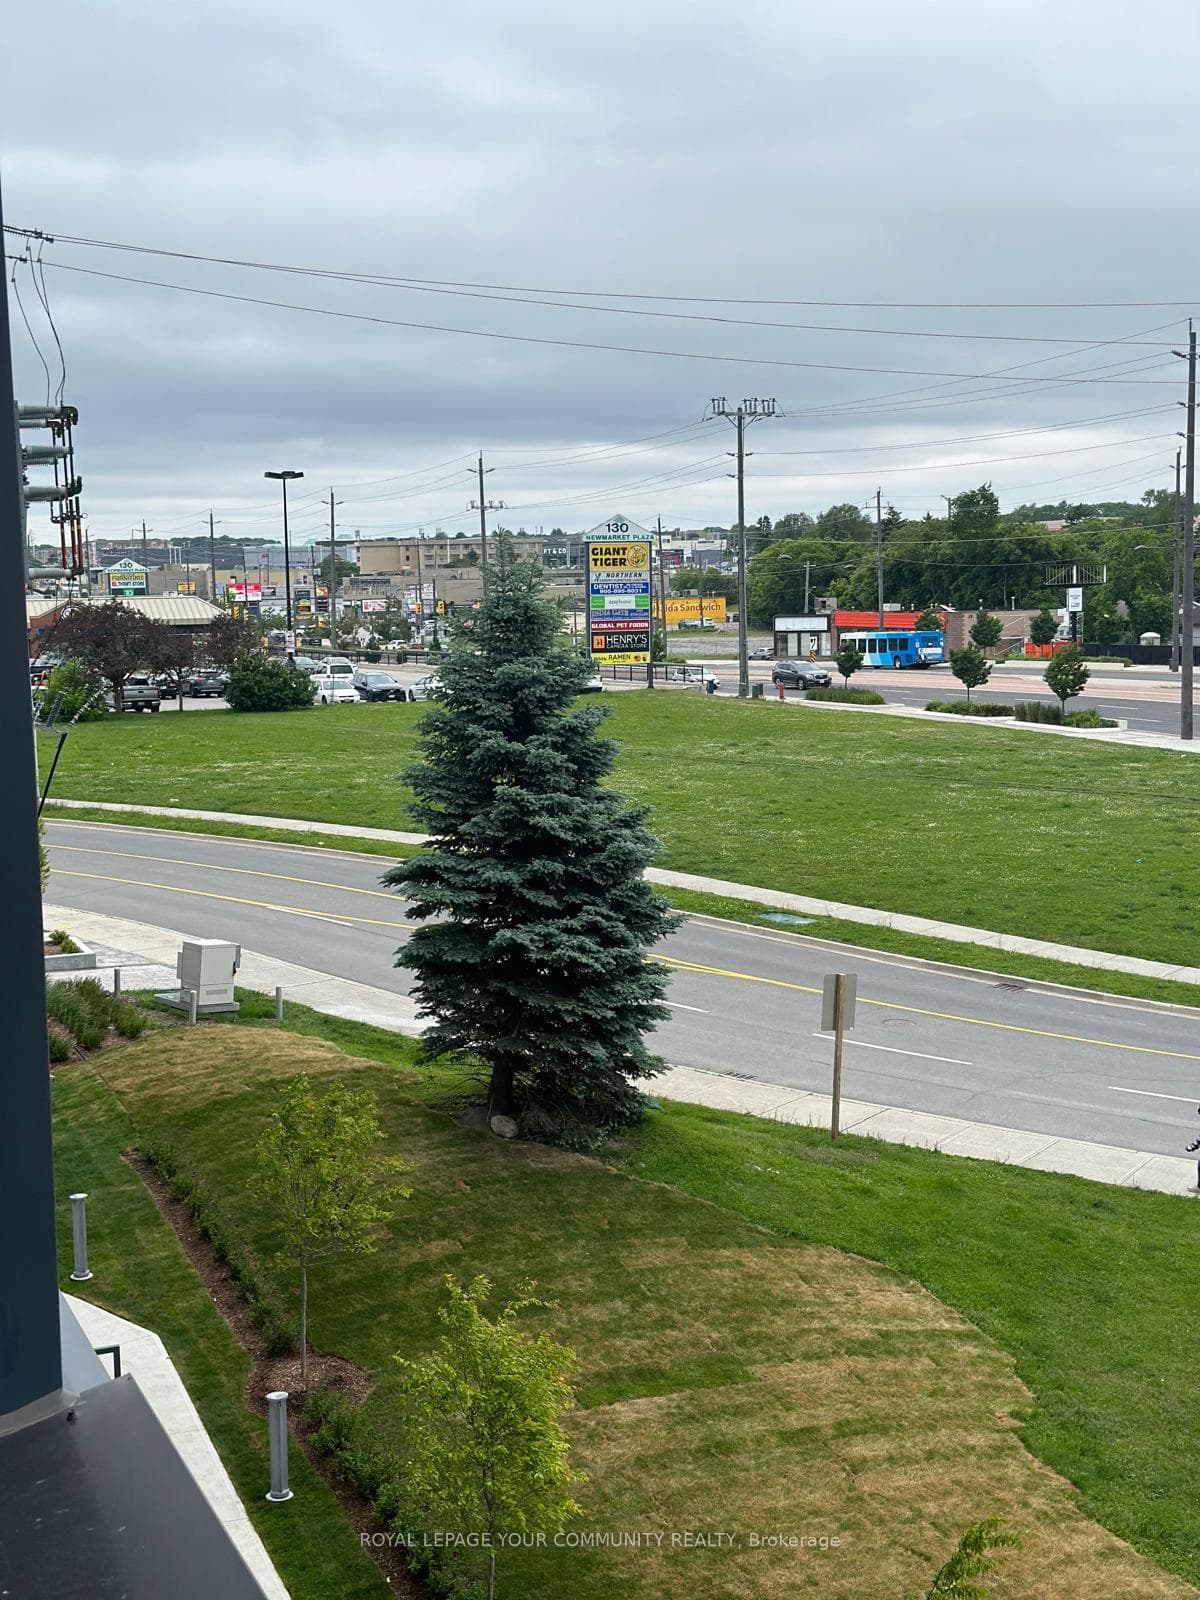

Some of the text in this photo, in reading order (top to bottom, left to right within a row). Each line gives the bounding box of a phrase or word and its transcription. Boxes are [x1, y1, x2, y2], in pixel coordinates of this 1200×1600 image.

[605, 523, 629, 533] 130
[591, 547, 628, 556] GIANT
[591, 557, 627, 567] TIGER
[606, 634, 648, 644] HENRY'S
[608, 653, 631, 661] RAMEN
